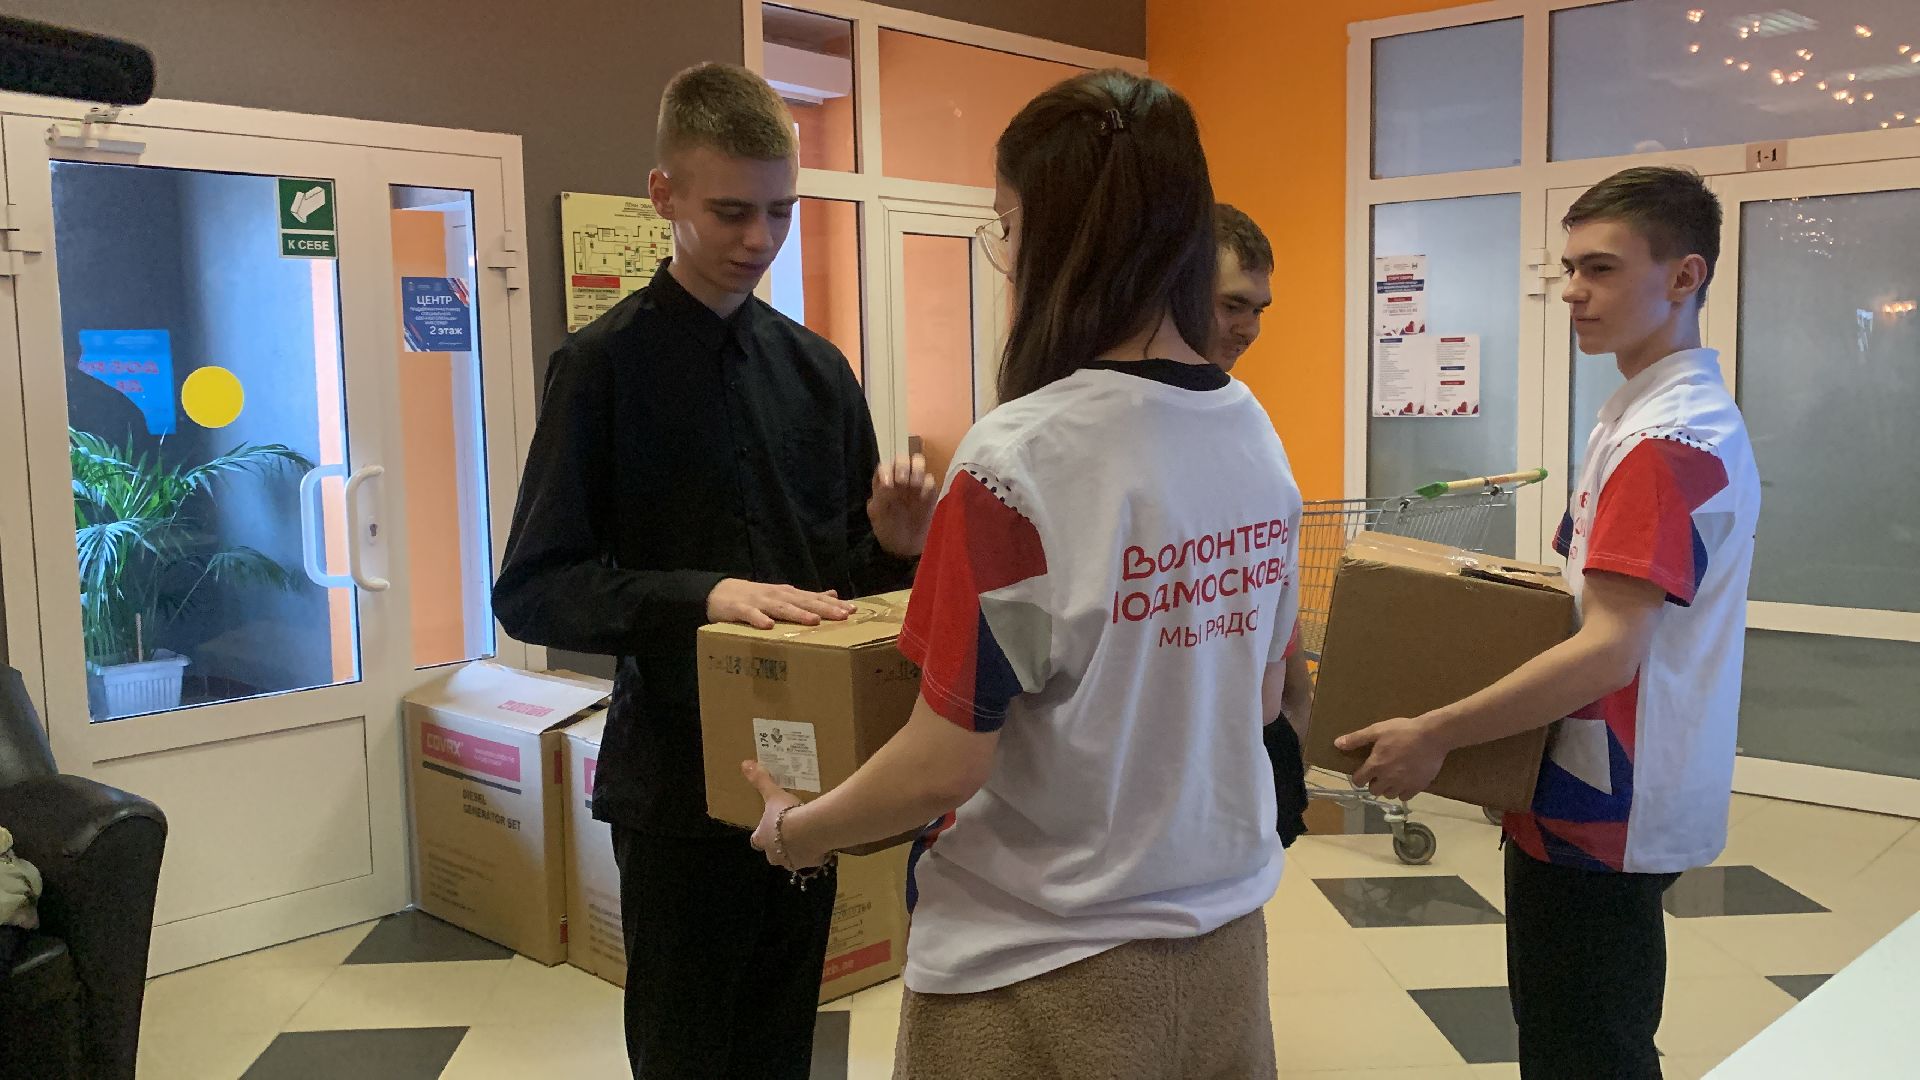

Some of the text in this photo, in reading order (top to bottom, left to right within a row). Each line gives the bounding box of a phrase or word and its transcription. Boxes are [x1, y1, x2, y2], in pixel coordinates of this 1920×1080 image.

[1757, 148, 1777, 163] 1-1
[288, 240, 330, 251] К СЕБЕ
[416, 295, 453, 306] ЦЕНТР
[429, 325, 463, 335] 2 этаж
[1112, 556, 1289, 624] ОДМОСКОВЬ
[1159, 604, 1260, 648] МЫ РЯДО
[760, 732, 769, 748] 176
[462, 789, 487, 805] DIESEL
[463, 804, 521, 831] GENERATOR SET
